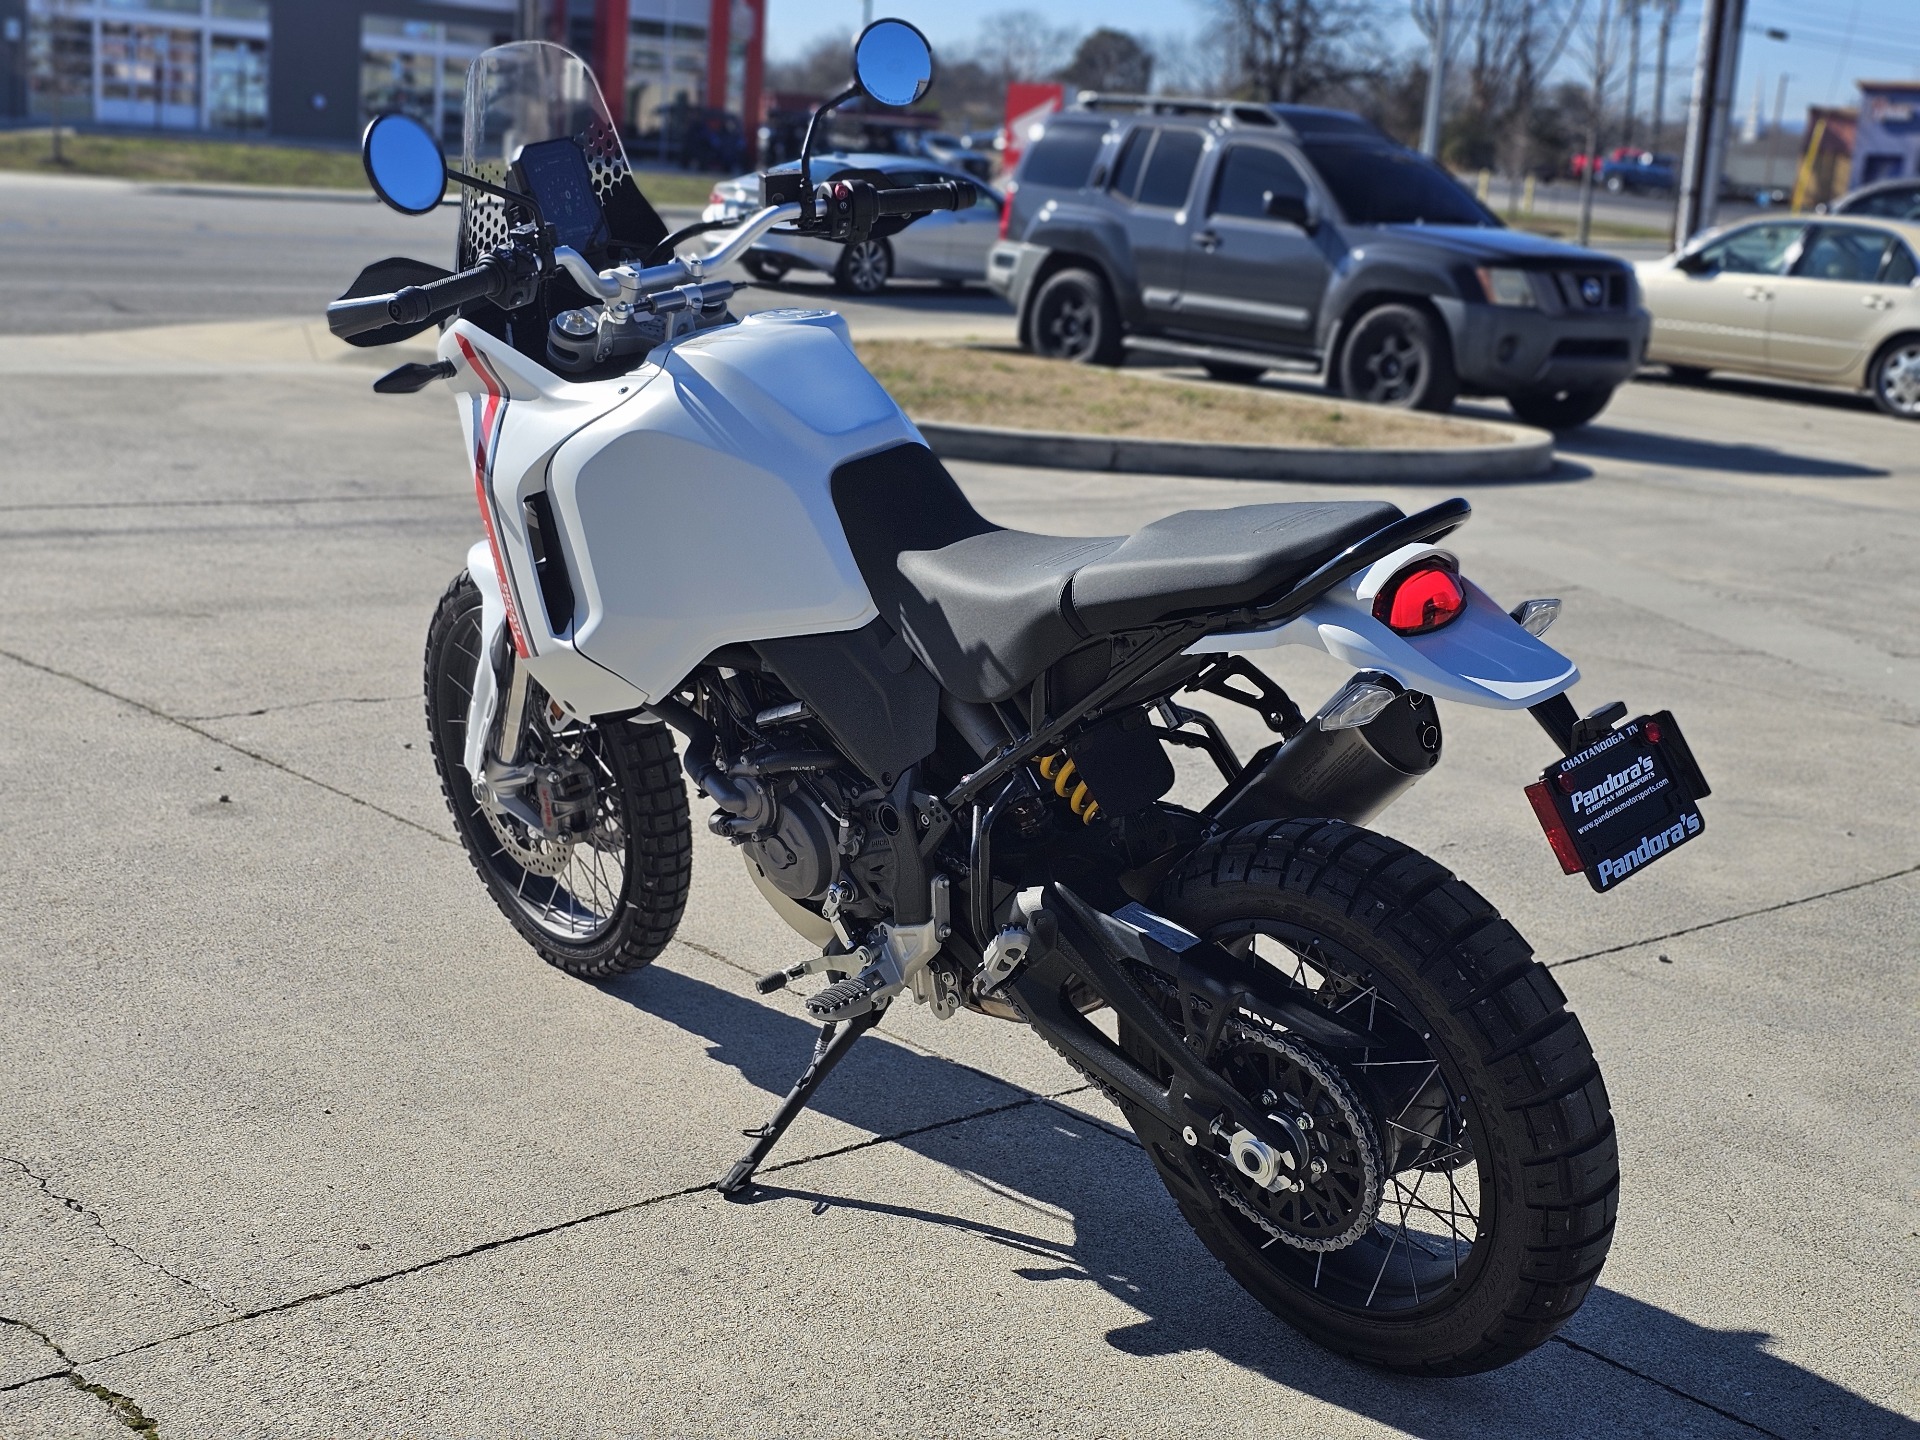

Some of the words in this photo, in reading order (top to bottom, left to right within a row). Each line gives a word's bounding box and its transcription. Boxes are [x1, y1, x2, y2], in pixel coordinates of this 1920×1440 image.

[1561, 732, 1625, 772] CHATTANOOGA
[1626, 723, 1639, 737] TN
[1571, 755, 1654, 814] Pandora's
[1577, 777, 1669, 835] www.pandorasmotorsports.com
[1585, 794, 1616, 816] EUROPEAN
[1615, 770, 1655, 802] MOTORSPORTS
[1597, 812, 1700, 887] Pandora's
